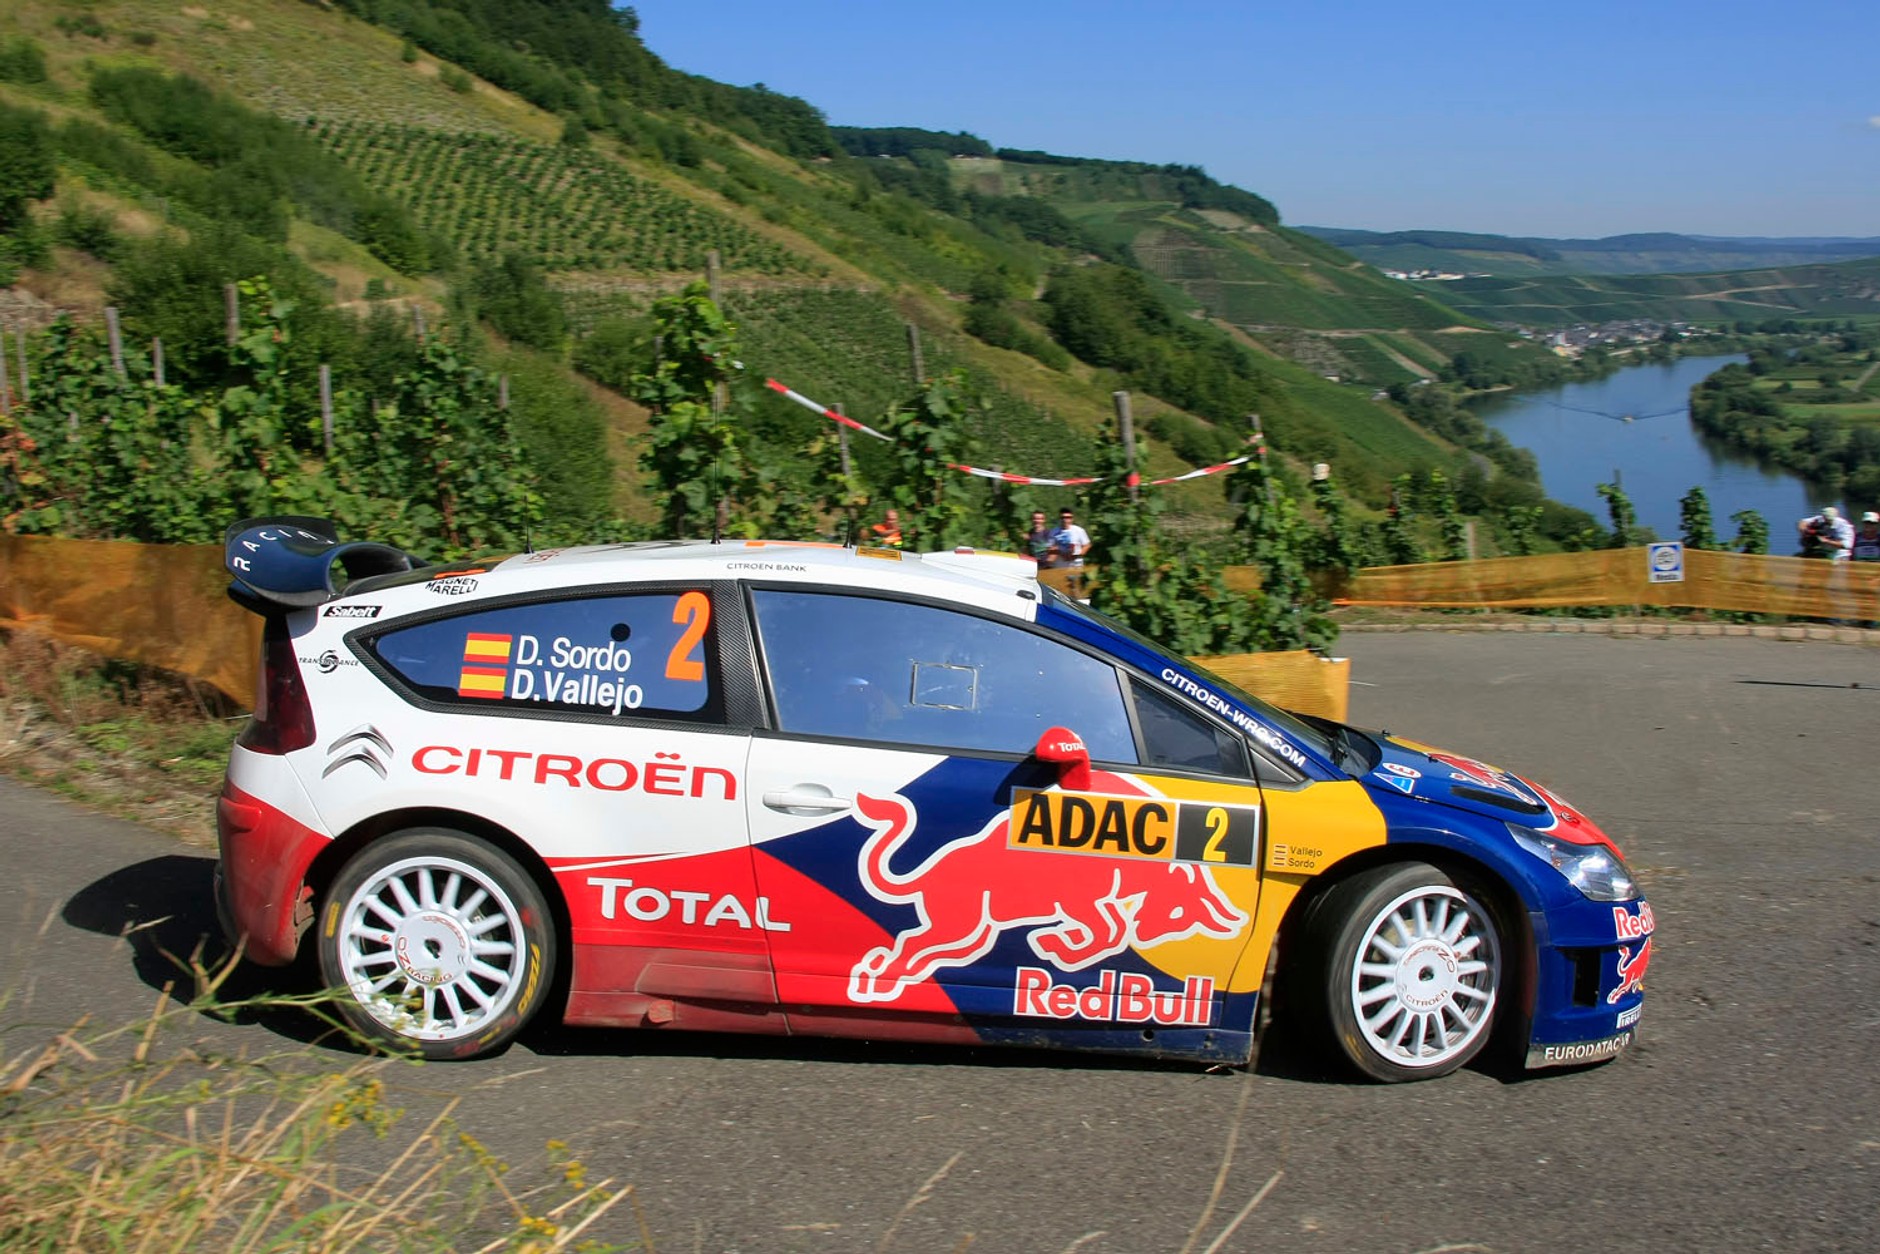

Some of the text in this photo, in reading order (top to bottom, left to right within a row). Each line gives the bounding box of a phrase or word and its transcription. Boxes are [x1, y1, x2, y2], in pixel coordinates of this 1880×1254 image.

[234, 529, 335, 571] RACIN
[776, 564, 806, 572] BANK
[425, 581, 479, 595] MARELLI
[329, 606, 376, 617] Sabelt
[665, 591, 711, 681] 2
[516, 635, 632, 673] D. Sordo
[1017, 792, 1230, 862] ADAC 2
[1288, 858, 1315, 868] Sordo
[1290, 846, 1323, 858] Vallejo
[587, 876, 791, 932] TOTAL
[1616, 1002, 1643, 1029] PIREL
